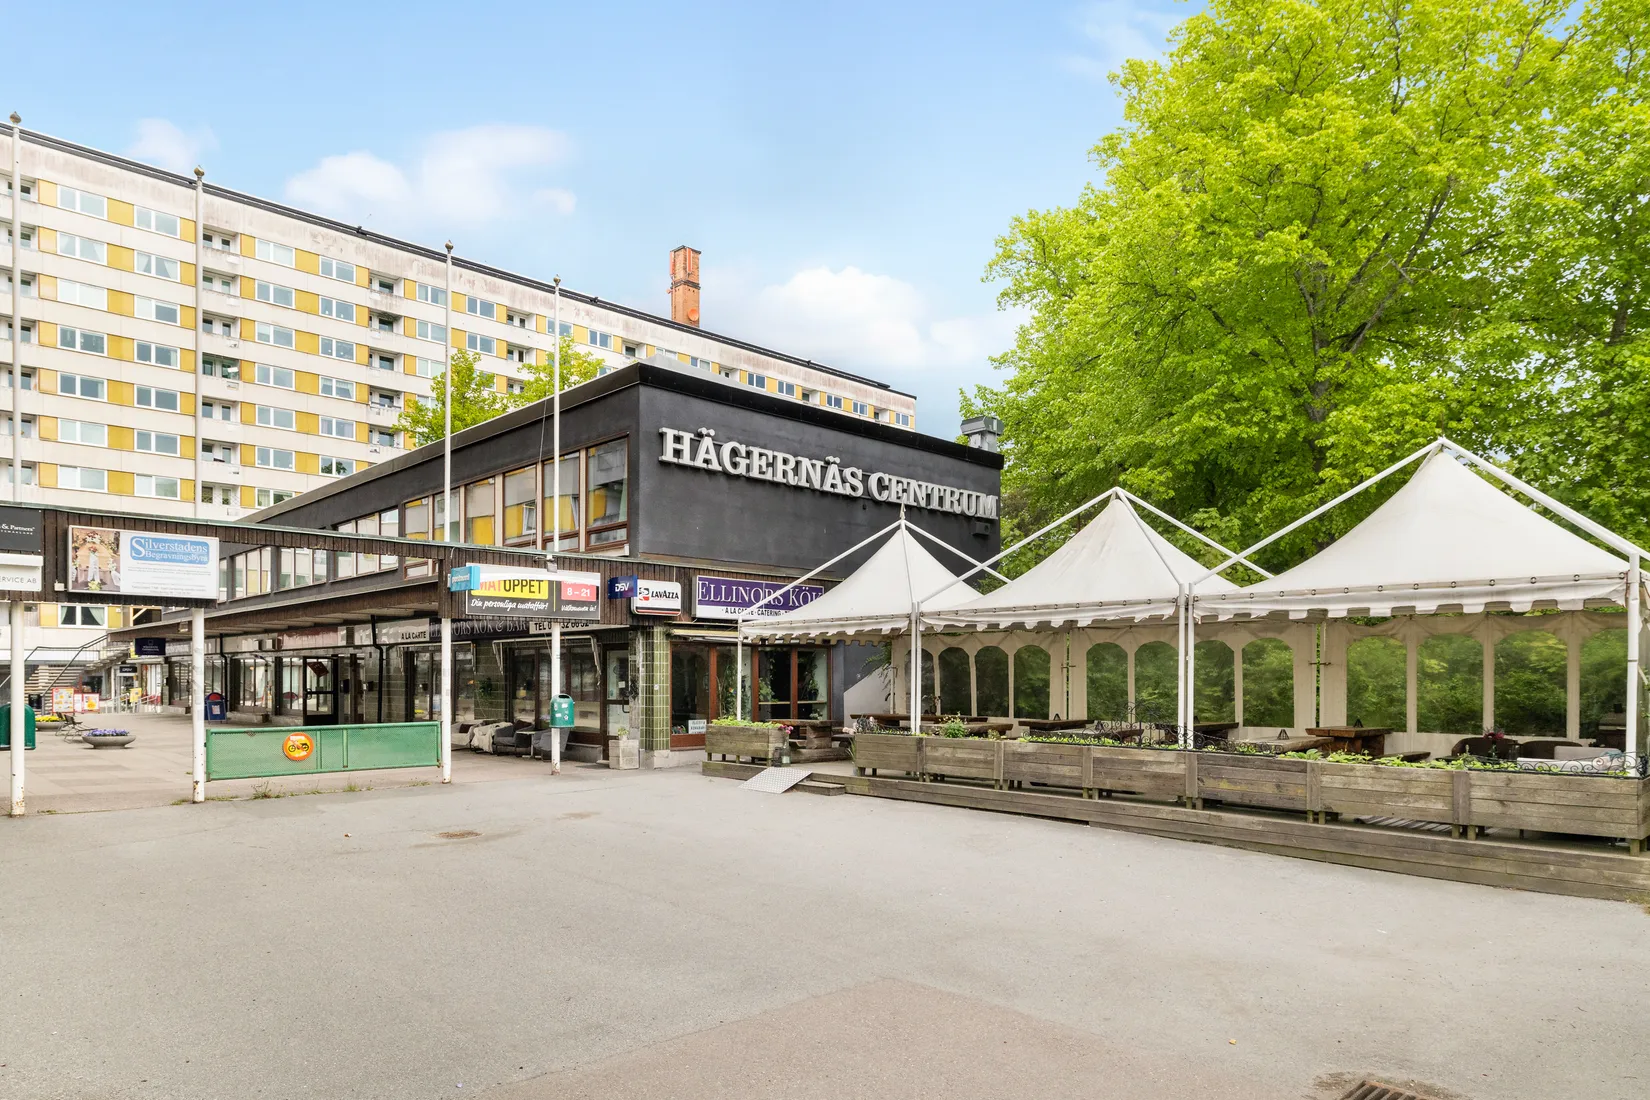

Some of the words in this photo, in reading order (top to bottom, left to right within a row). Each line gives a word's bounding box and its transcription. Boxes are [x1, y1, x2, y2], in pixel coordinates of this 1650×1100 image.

[659, 427, 864, 498] HÄGERNÄS
[868, 472, 999, 519] CENTRUM
[131, 537, 208, 558] Silverstadens
[145, 550, 208, 563] Begravningsbyrå
[567, 587, 573, 596] 8
[580, 588, 591, 597] 21
[615, 583, 630, 592] DSV
[651, 590, 679, 599] LAVAZZA
[698, 581, 784, 606] ELLINORS
[482, 600, 516, 612] personliga
[757, 609, 782, 617] CATERING
[535, 622, 546, 631] TEL
[405, 632, 411, 640] LA
